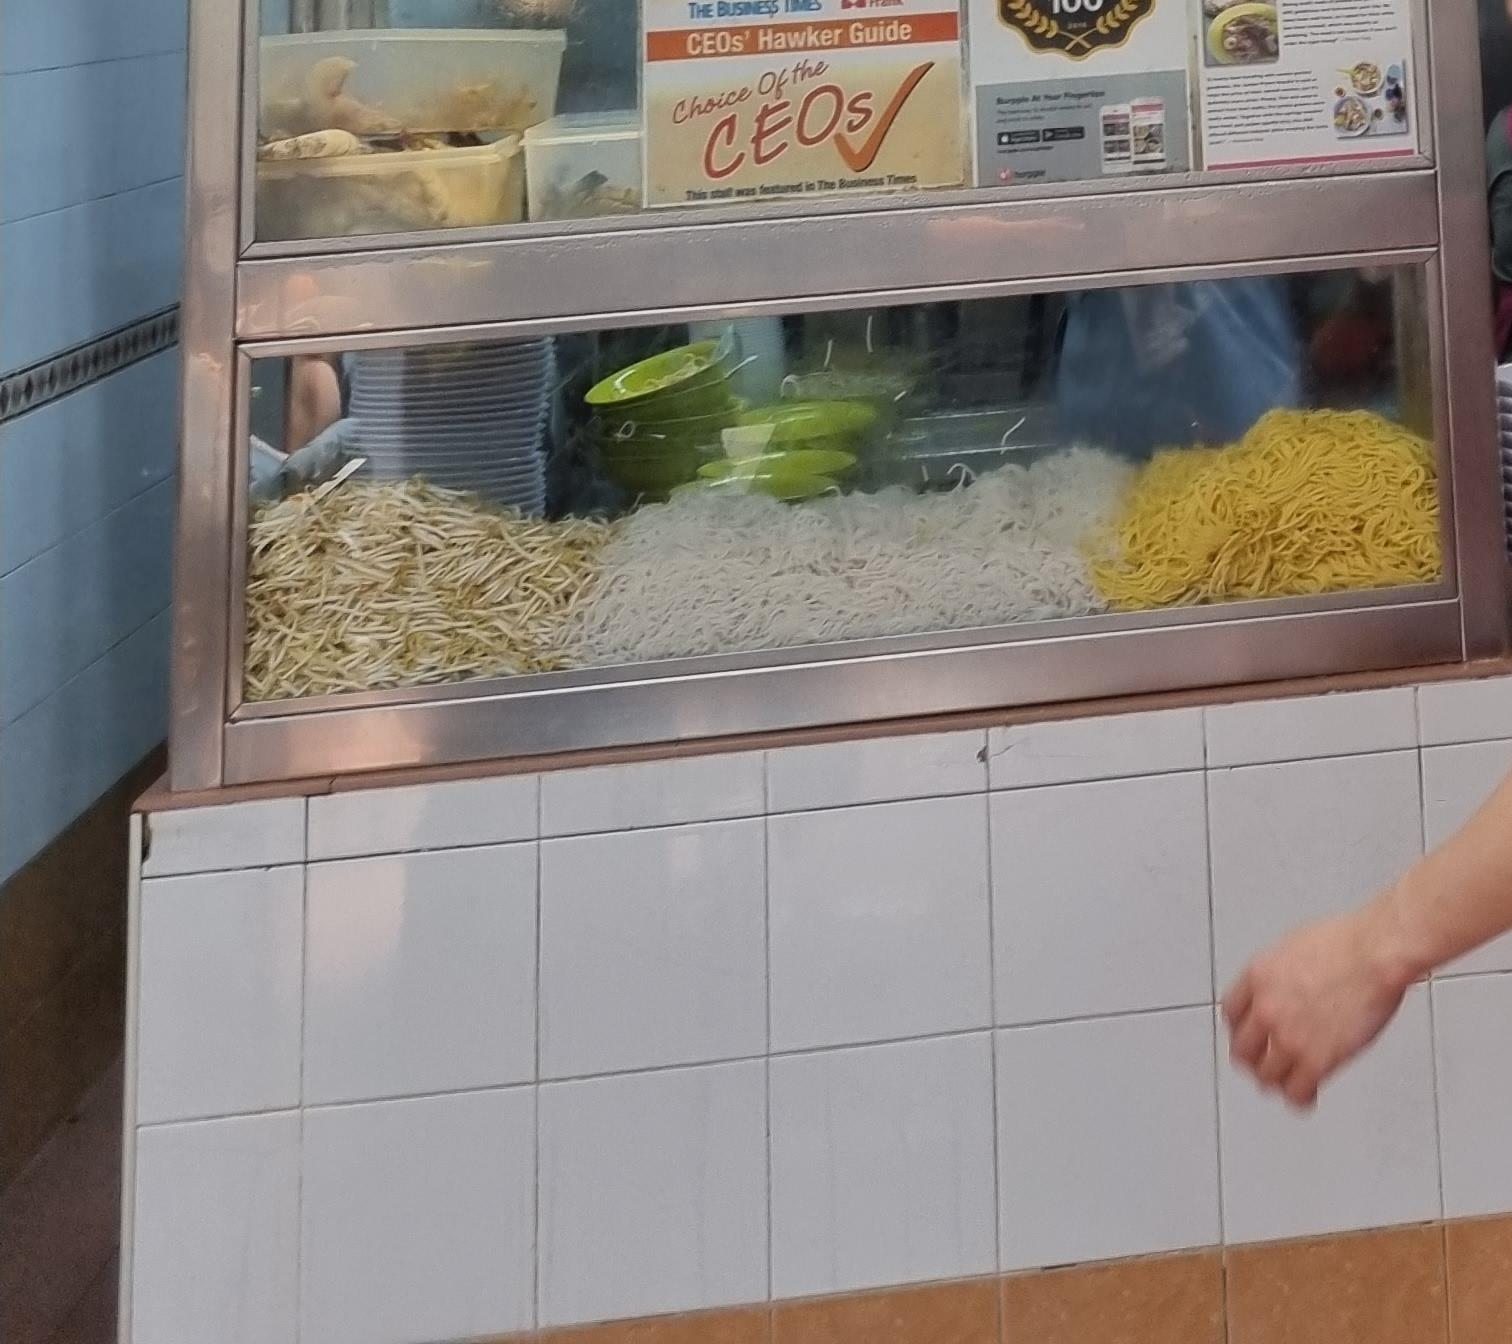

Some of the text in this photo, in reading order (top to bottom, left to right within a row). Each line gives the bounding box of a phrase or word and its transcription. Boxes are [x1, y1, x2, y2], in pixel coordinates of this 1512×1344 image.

[686, 20, 912, 55] CEOs' Hawker Guide
[672, 59, 829, 124] Choice Of the
[704, 84, 873, 179] CEOs
[686, 190, 707, 201] This
[736, 187, 755, 197] was
[759, 183, 802, 195] featured
[805, 181, 815, 191] in
[817, 179, 836, 190] The
[839, 176, 885, 190] Business
[887, 174, 917, 185] Times
